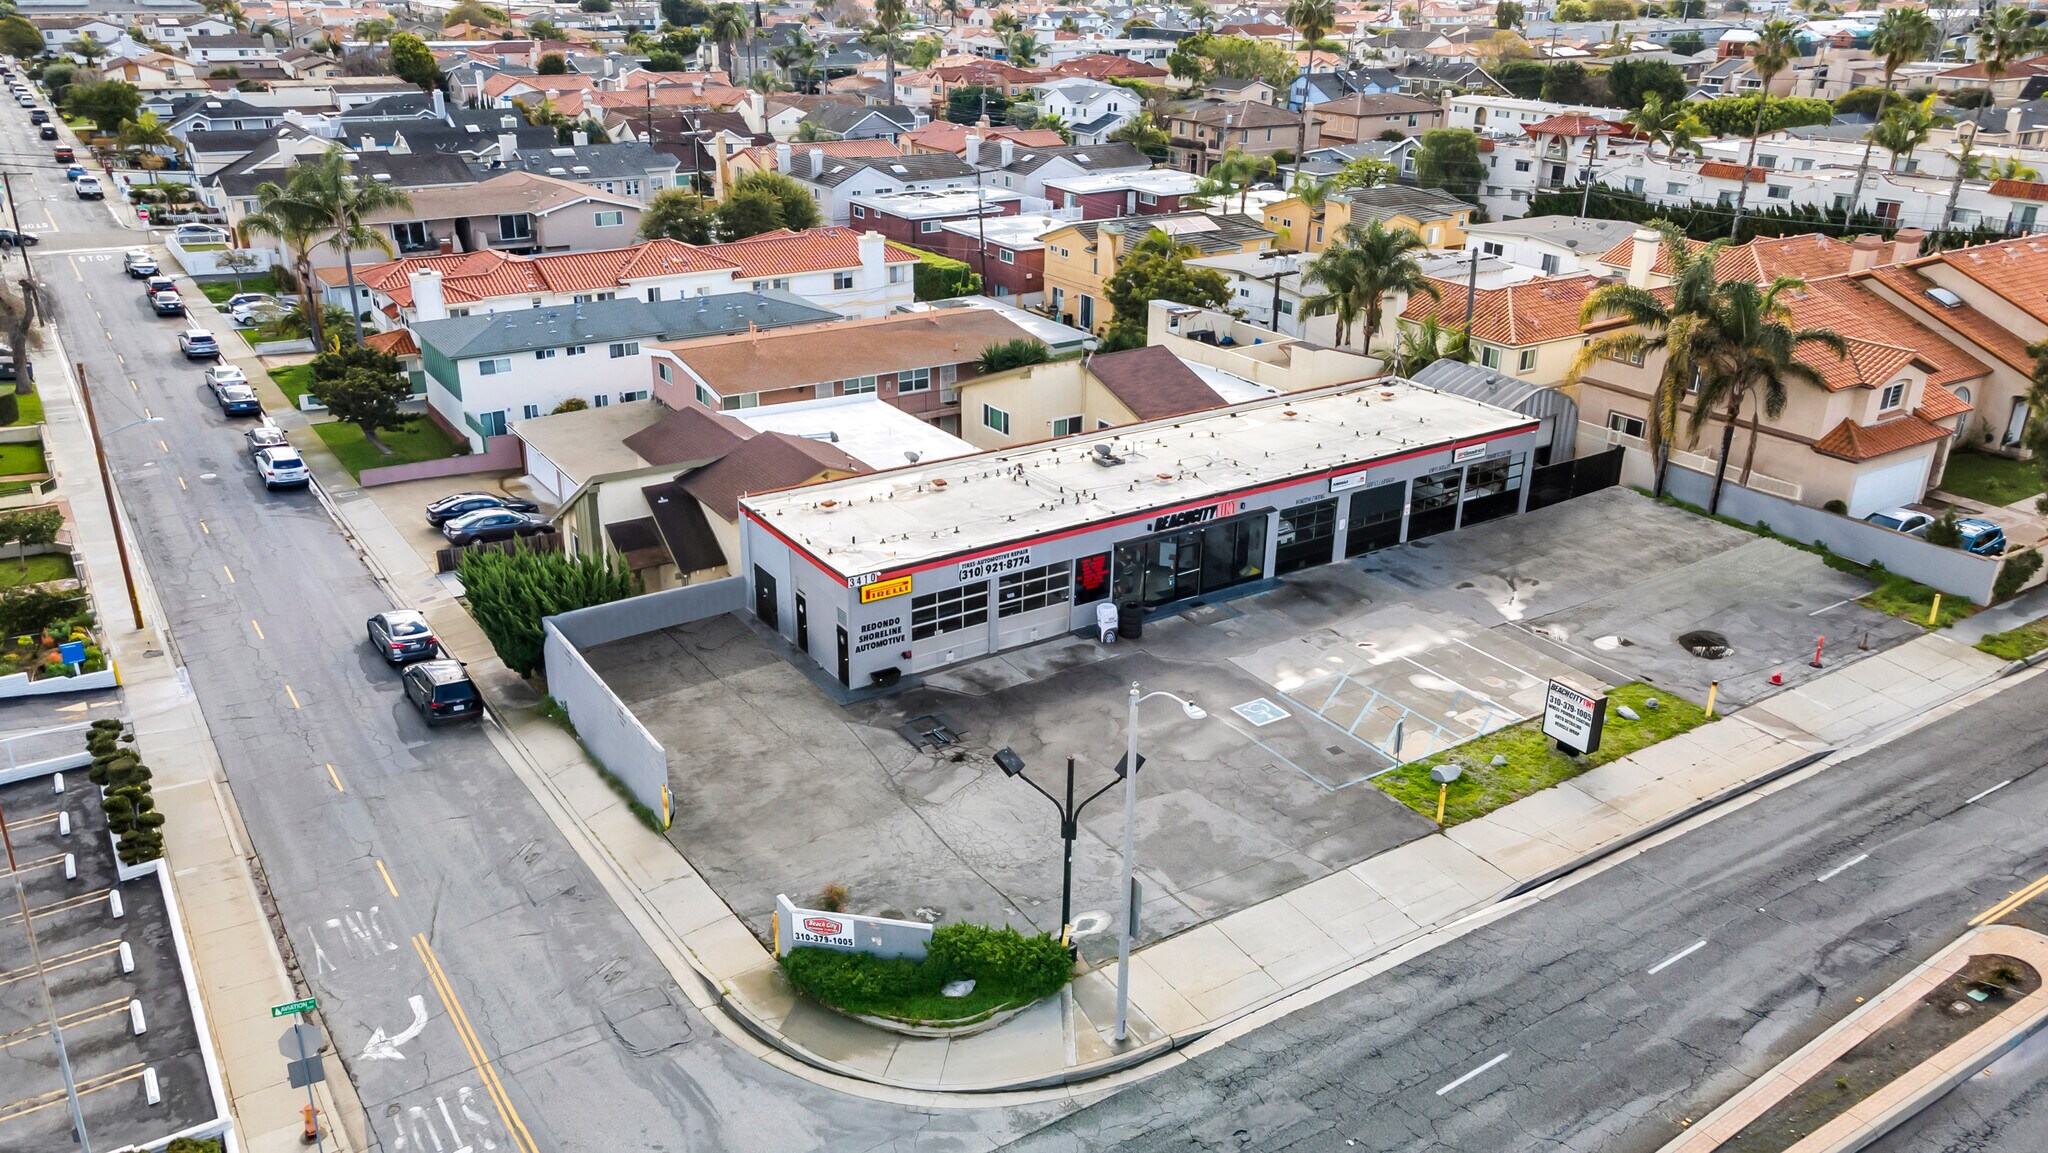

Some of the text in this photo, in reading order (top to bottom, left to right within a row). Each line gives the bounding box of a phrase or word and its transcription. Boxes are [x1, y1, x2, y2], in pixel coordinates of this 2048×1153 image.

[22, 222, 49, 230] STOP
[78, 255, 112, 263] STOP
[1010, 548, 1029, 558] REPAIR
[958, 554, 1030, 582] (310) 921-8774
[849, 572, 877, 588] 3410
[865, 580, 909, 600] PIRELLI
[860, 616, 901, 634] REDONDO
[858, 625, 902, 644] SHORELINE
[854, 634, 906, 654] AUTOMOTIVE
[1550, 696, 1591, 721] 310-379-1005
[827, 922, 837, 930] City
[795, 932, 853, 945] 310-379-1005
[280, 1001, 308, 1012] AVIATION
